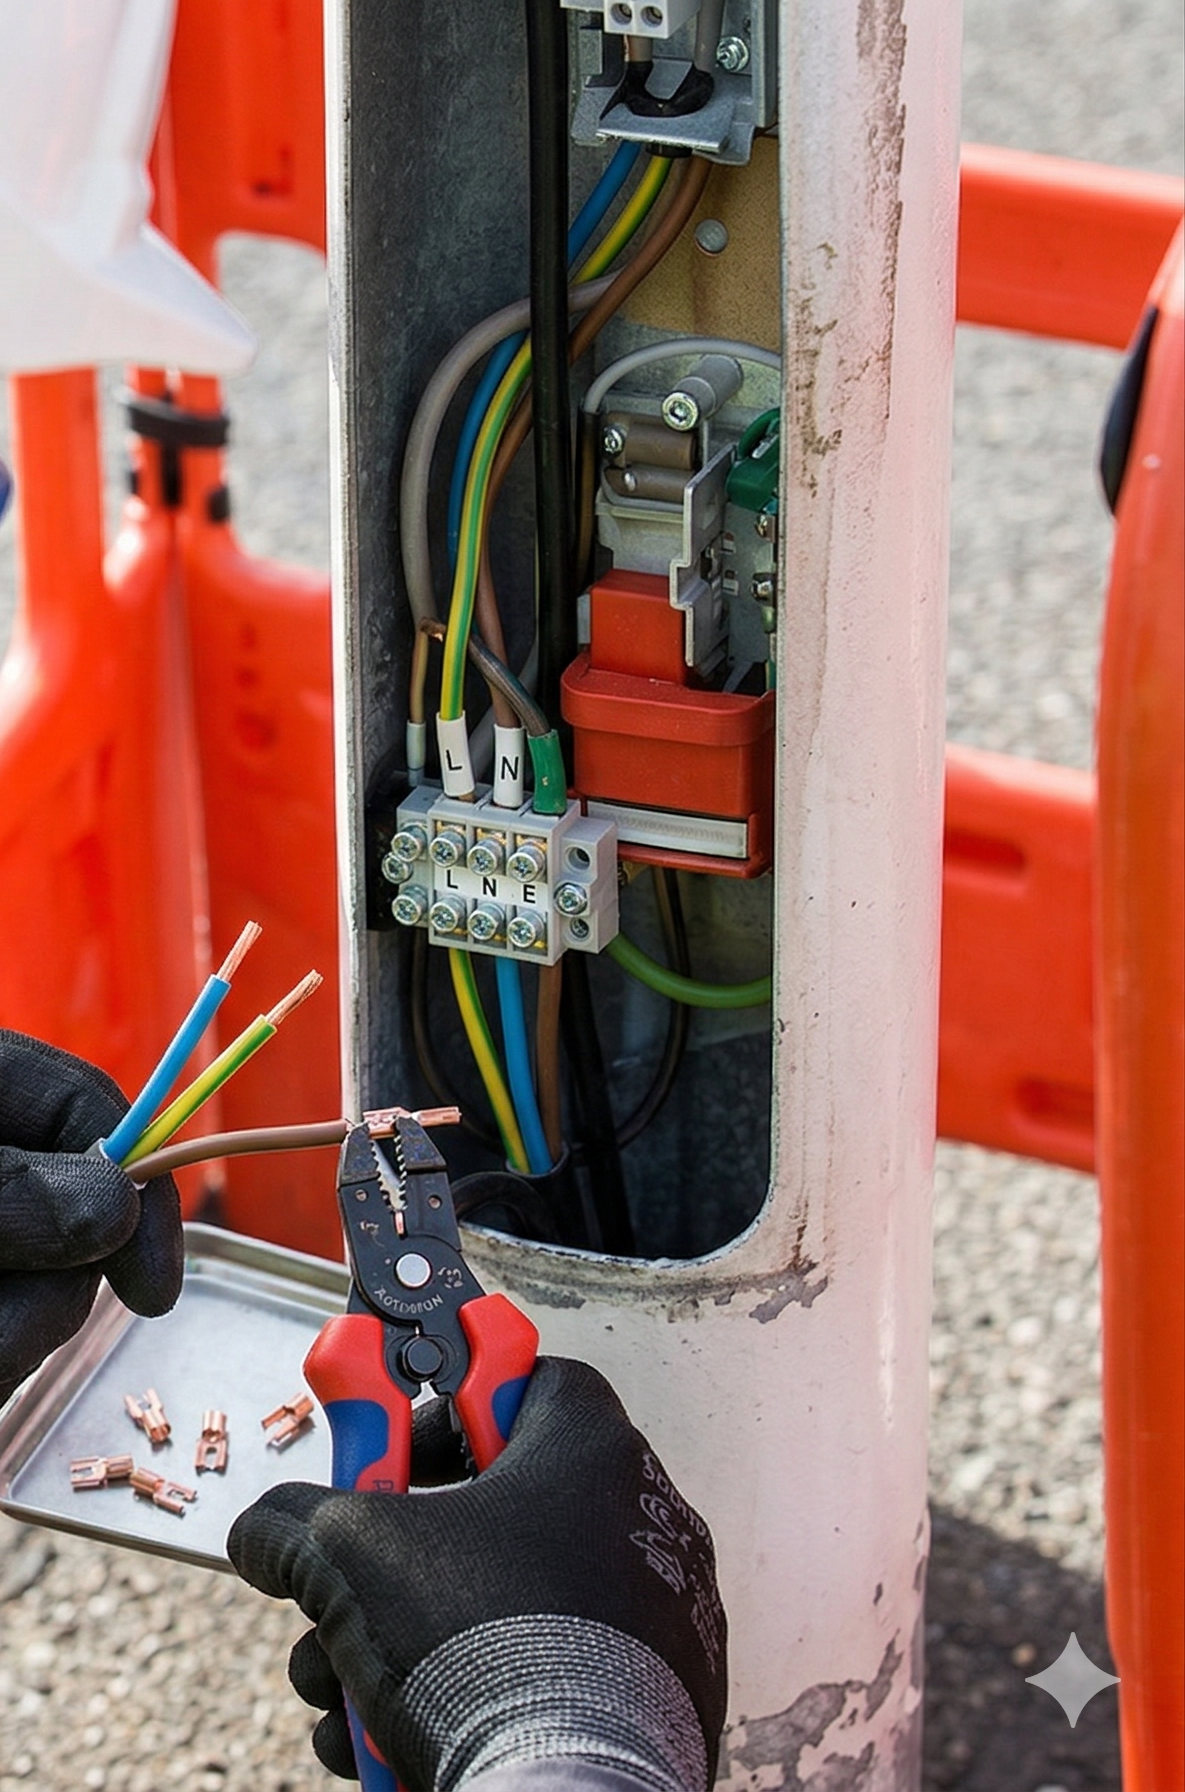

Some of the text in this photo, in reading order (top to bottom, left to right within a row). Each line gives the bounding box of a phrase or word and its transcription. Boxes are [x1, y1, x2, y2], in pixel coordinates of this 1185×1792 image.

[446, 750, 462, 771] L
[501, 756, 518, 780] N
[446, 869, 536, 903] L N E
